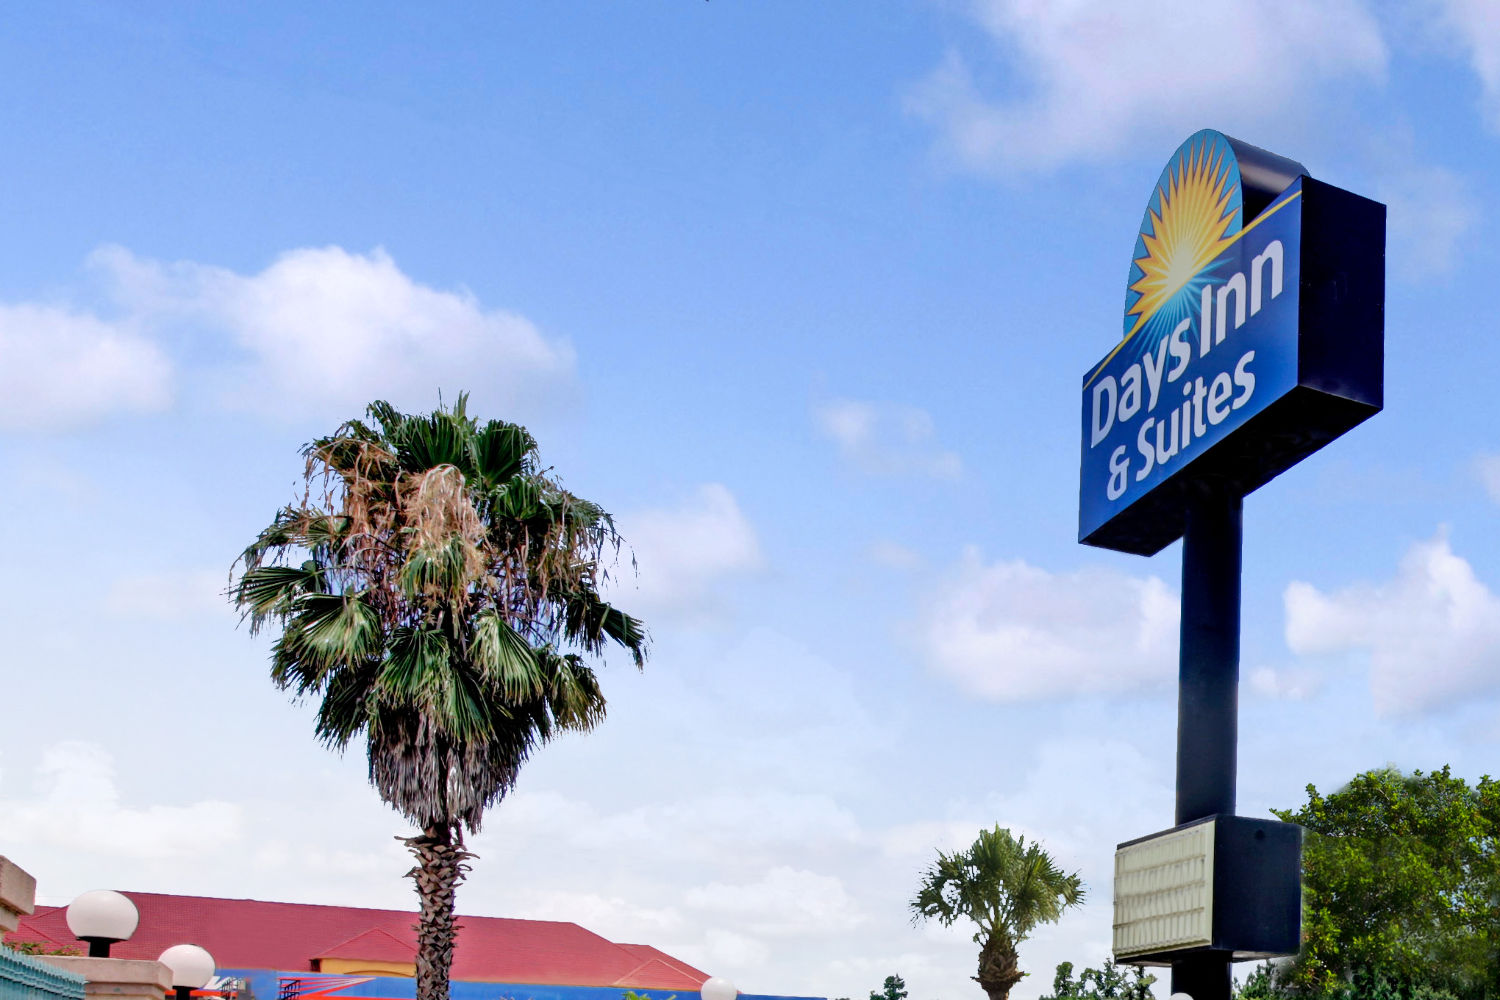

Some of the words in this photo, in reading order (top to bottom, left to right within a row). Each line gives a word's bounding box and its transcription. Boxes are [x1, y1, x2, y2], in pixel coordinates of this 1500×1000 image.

[1091, 317, 1191, 448] Days
[1200, 239, 1283, 359] Inn
[1107, 444, 1130, 501] &
[1136, 350, 1255, 482] Suites
